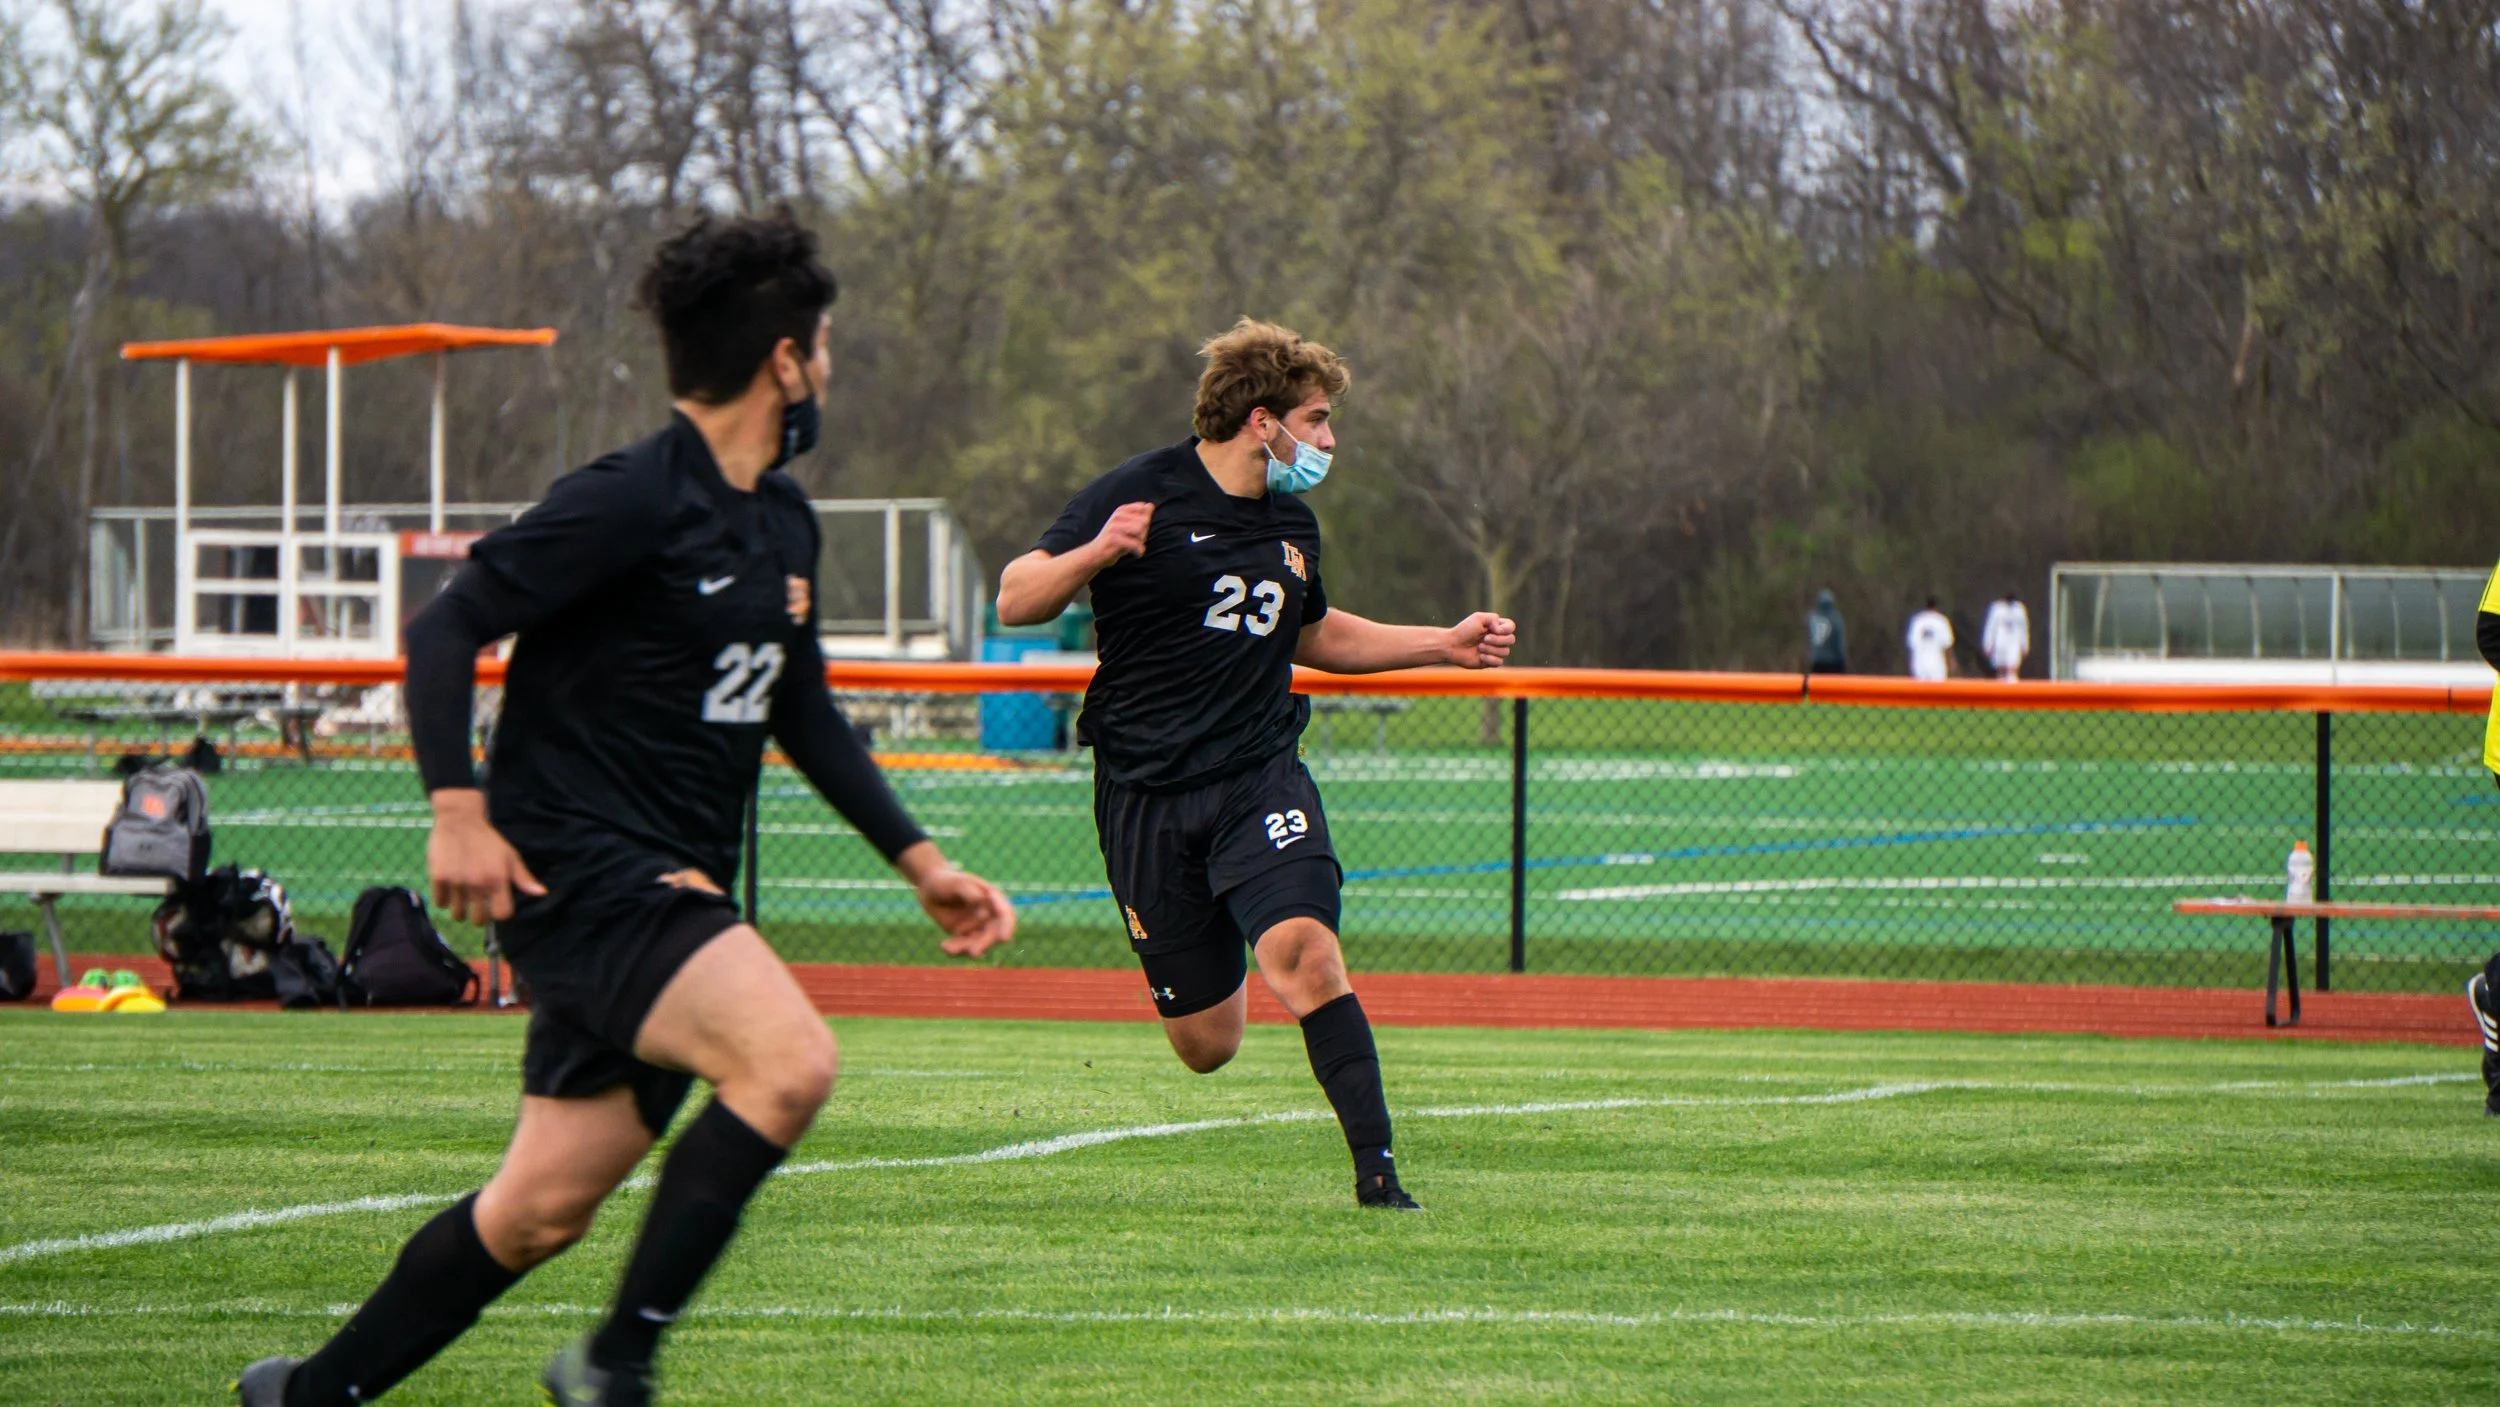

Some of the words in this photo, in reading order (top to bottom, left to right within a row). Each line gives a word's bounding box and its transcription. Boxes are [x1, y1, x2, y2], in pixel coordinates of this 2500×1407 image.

[1204, 575, 1286, 637] 23
[702, 642, 786, 723] 22
[1265, 808, 1309, 841] 23
